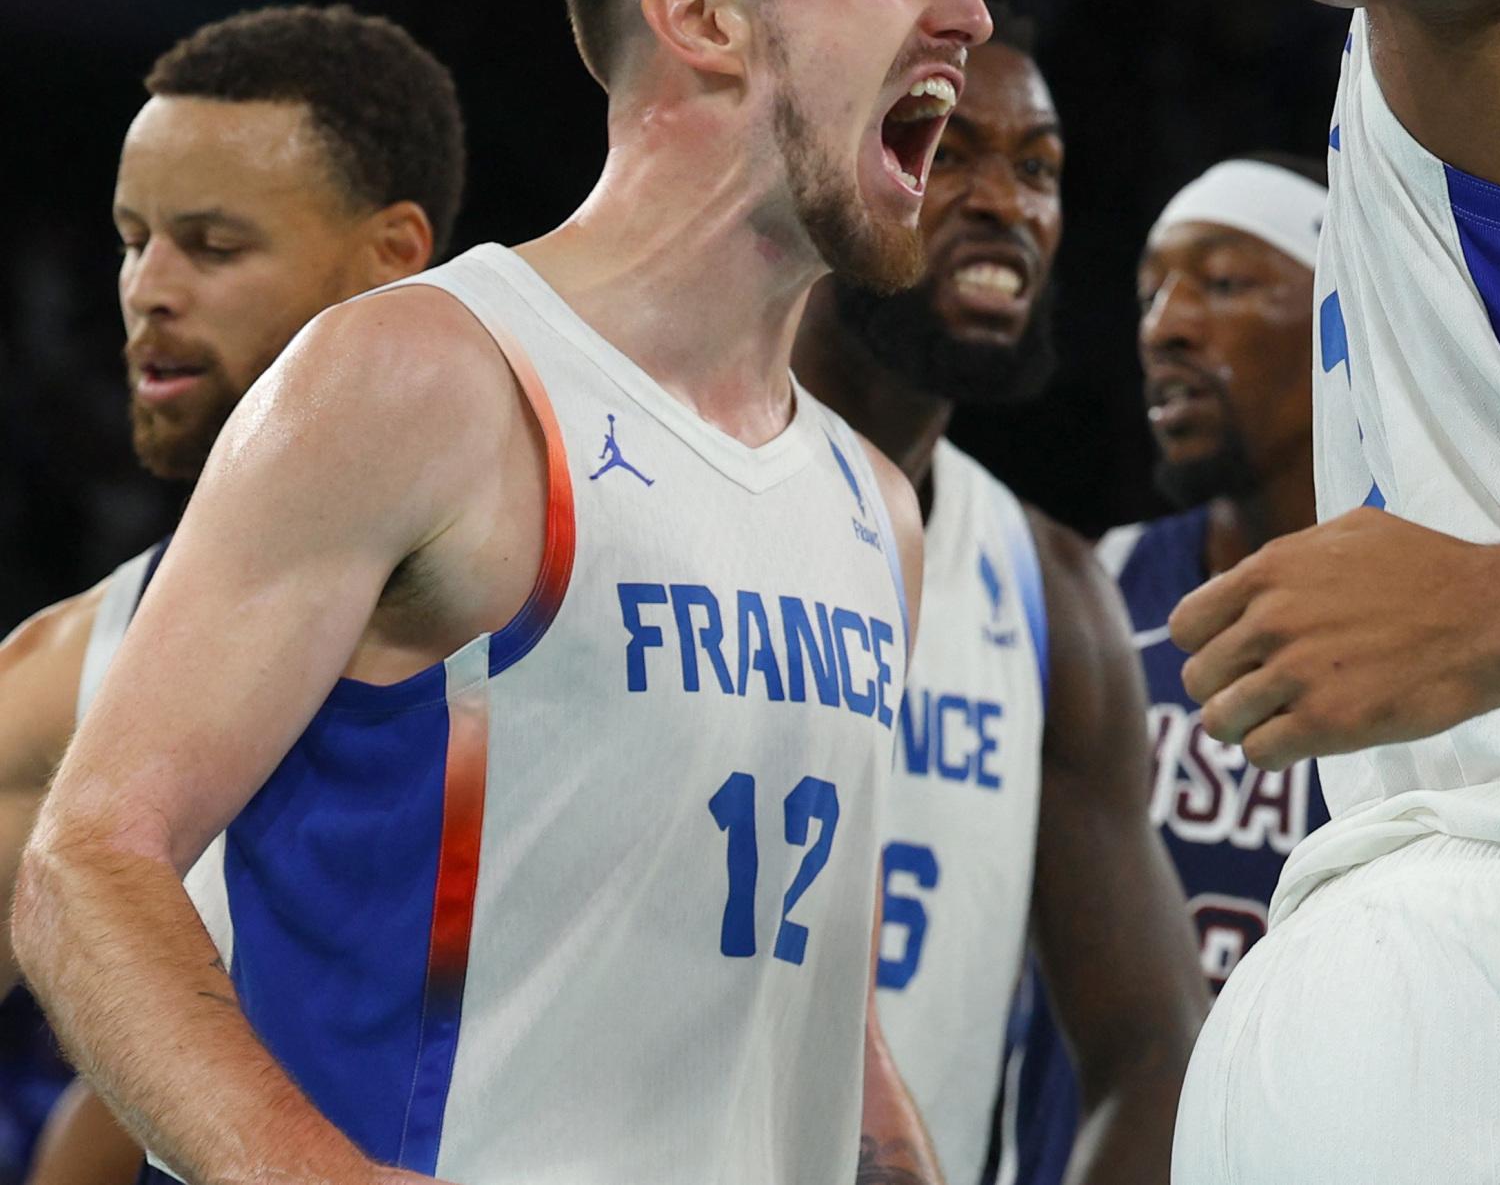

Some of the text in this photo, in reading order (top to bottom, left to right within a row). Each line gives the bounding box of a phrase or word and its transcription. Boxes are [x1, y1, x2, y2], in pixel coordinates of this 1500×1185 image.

[617, 583, 893, 731] FRANCE
[900, 689, 1003, 791] NCE
[708, 771, 840, 966] 12
[876, 839, 939, 992] 6
